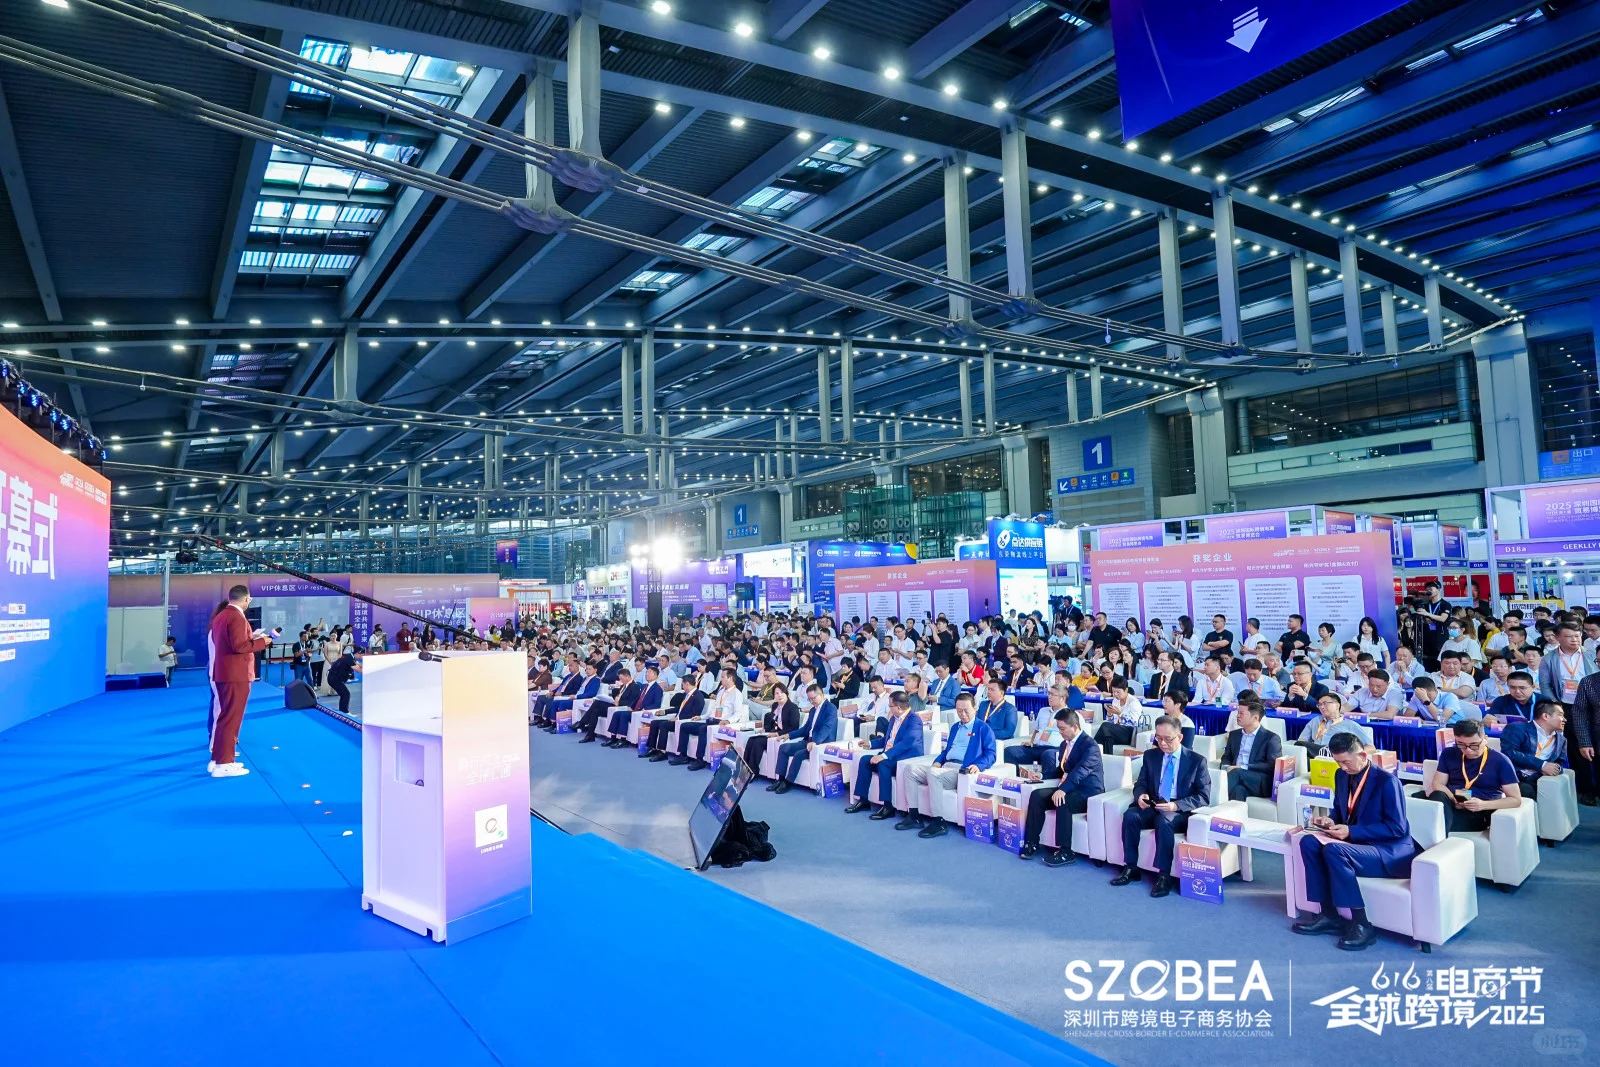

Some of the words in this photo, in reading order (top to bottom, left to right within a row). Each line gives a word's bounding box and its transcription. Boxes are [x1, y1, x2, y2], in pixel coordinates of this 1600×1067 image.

[1091, 442, 1103, 465] 1
[1572, 448, 1593, 458] 出口
[1545, 501, 1572, 511] 2025
[1574, 506, 1600, 514] 贸易博
[737, 507, 743, 522] 1
[0, 469, 58, 580] 幕式
[1218, 528, 1235, 536] 2025
[1192, 552, 1233, 564] 获奖企业
[261, 584, 296, 592] VIP休息区
[412, 607, 466, 619] VIP休息区
